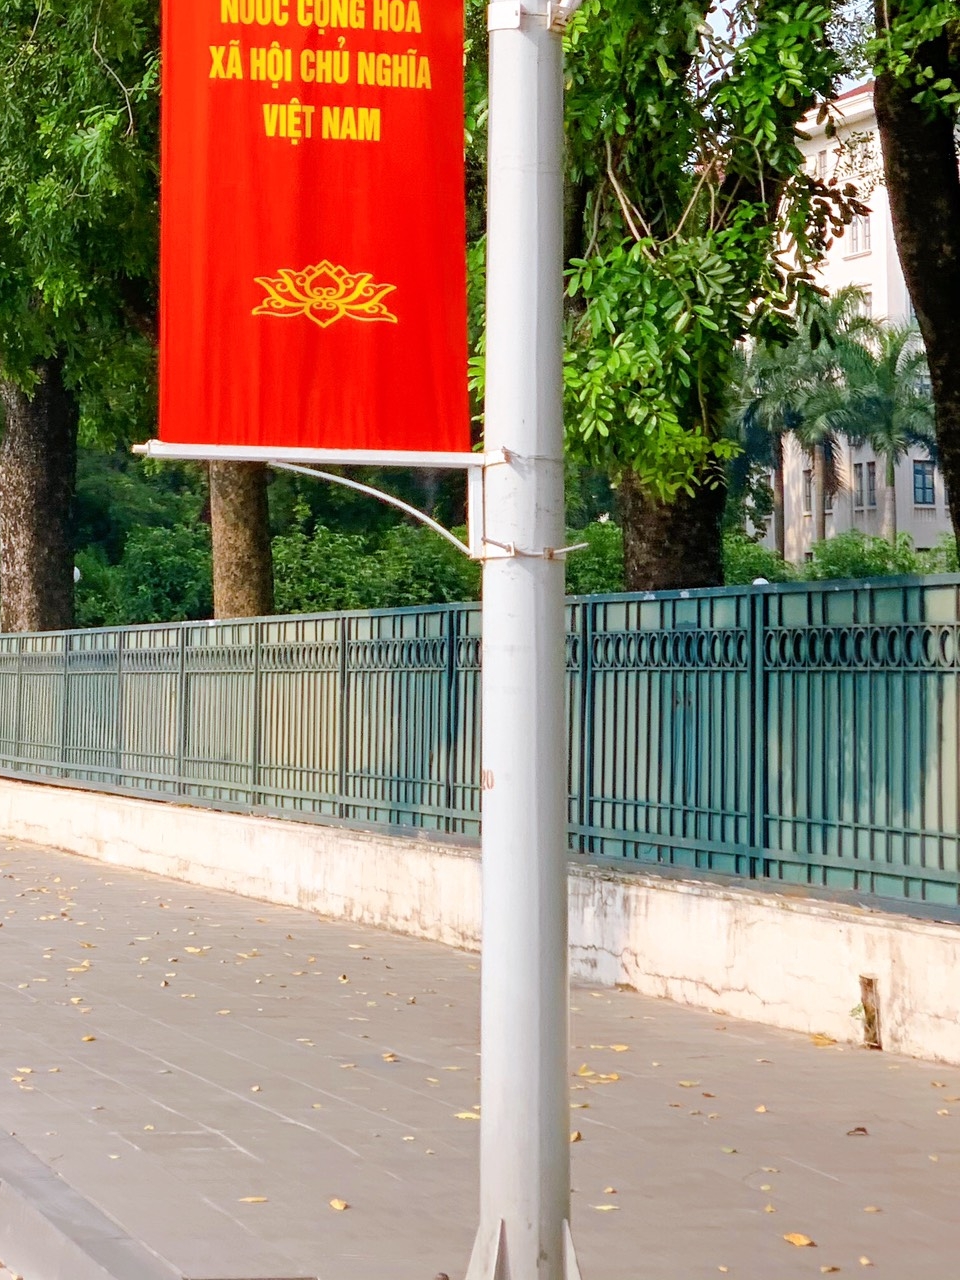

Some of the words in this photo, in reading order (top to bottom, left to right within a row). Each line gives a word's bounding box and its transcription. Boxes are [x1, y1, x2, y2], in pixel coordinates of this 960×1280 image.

[209, 39, 244, 80] XÃ
[250, 41, 293, 89] HỘI
[300, 35, 350, 85] CHỦ
[357, 48, 432, 89] NGHĨA
[262, 97, 315, 145] VIỆT
[322, 106, 381, 142] NAM
